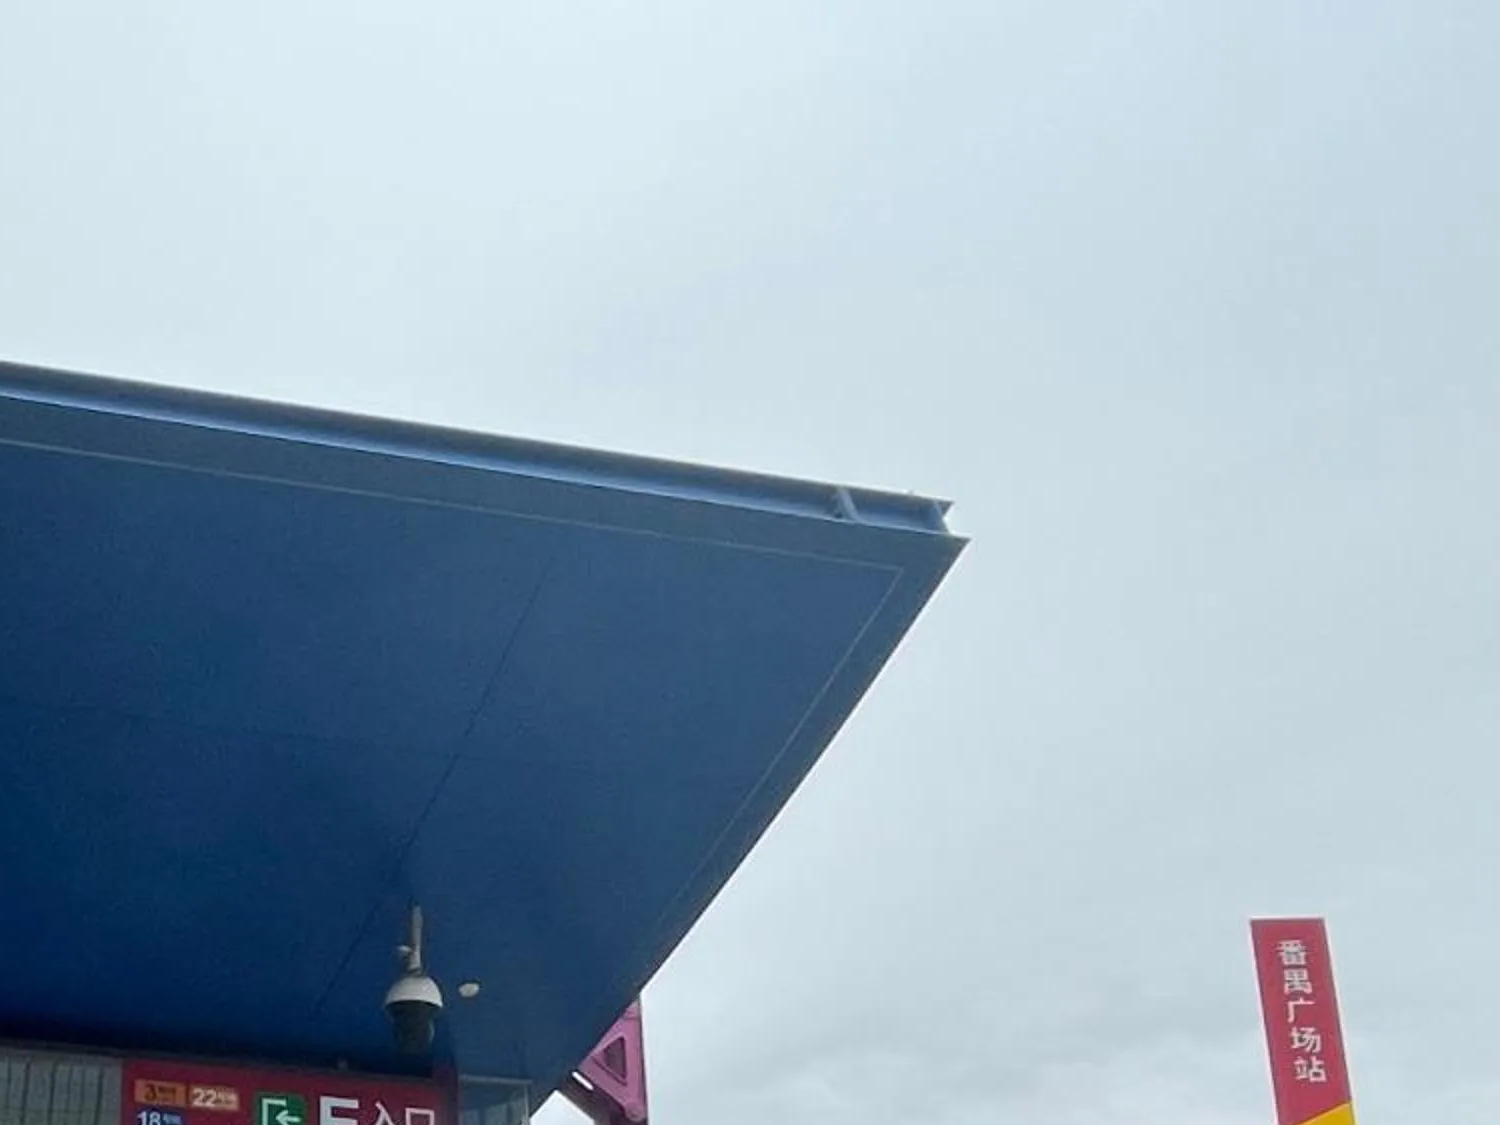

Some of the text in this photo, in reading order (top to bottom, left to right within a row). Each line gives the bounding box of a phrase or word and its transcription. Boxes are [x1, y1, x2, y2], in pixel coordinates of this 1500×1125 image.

[1276, 938, 1328, 1083] 番禺广场站
